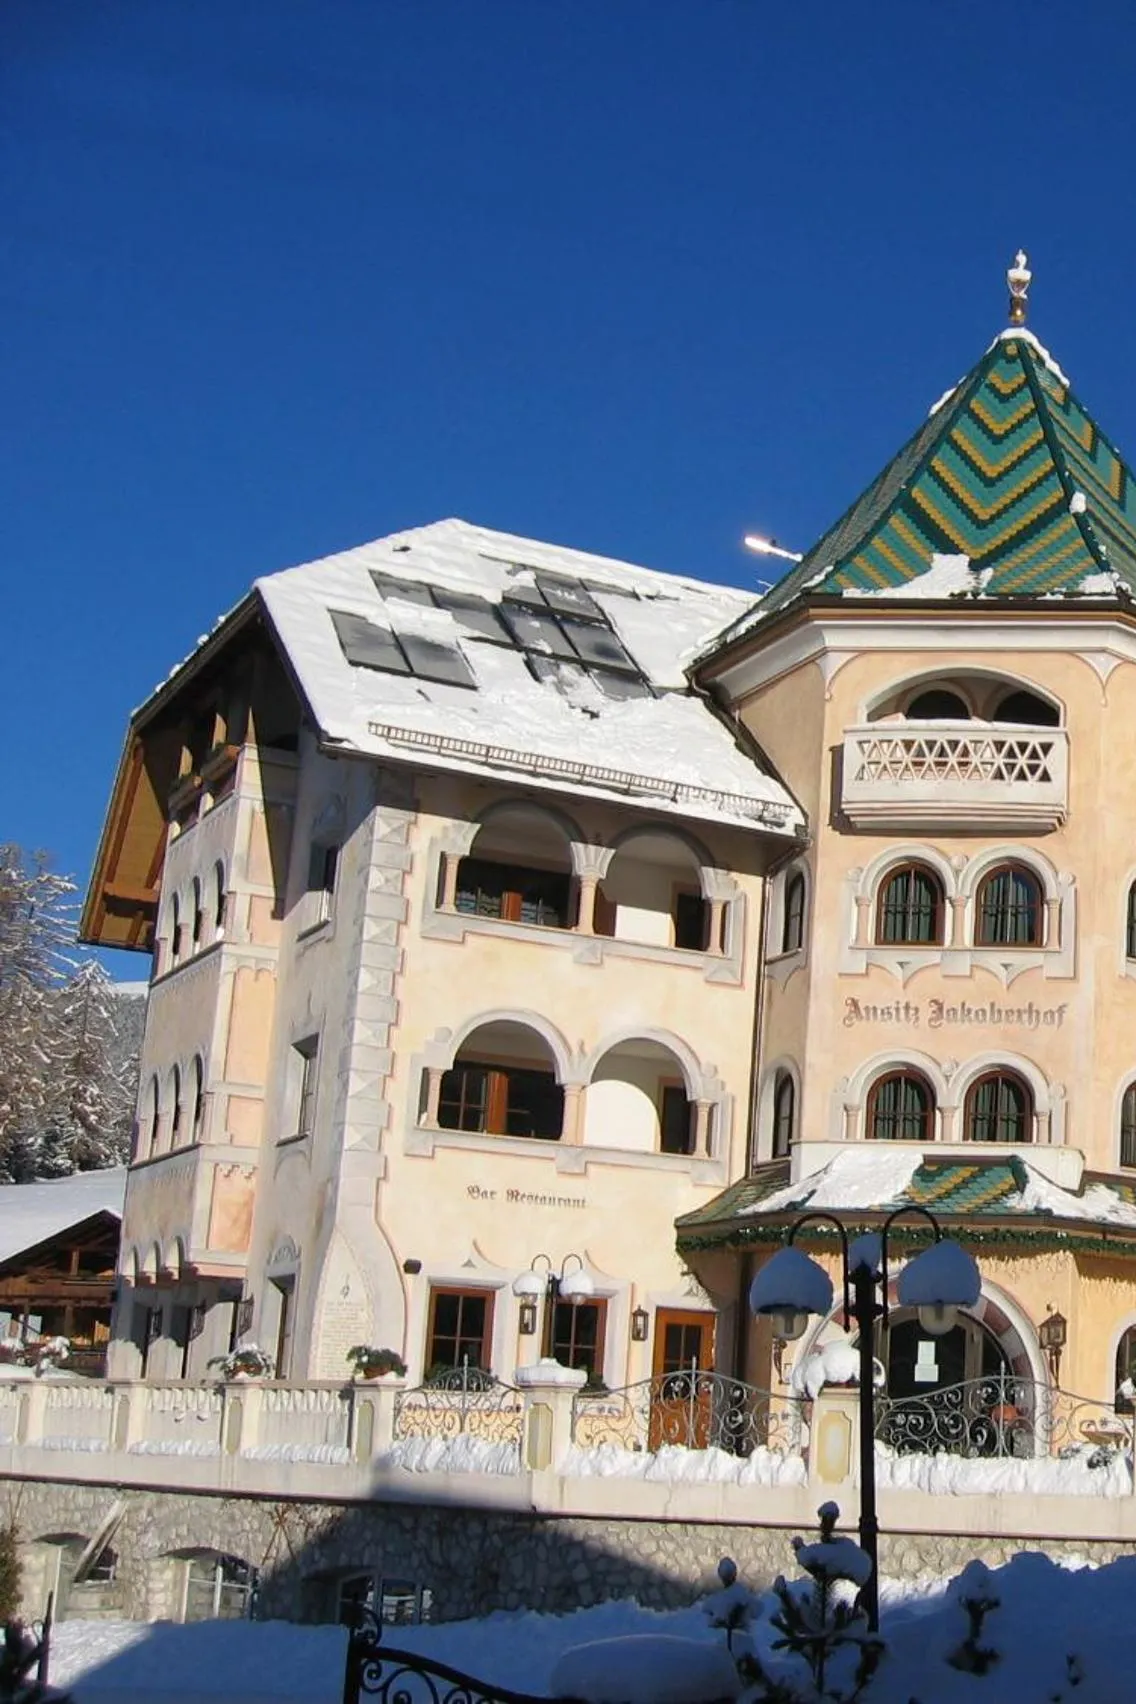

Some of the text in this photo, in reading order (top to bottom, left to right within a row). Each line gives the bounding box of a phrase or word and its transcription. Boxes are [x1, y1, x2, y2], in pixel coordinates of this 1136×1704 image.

[843, 997, 1068, 1031] Ansitz Jakoberhof
[467, 1185, 586, 1208] Bar Restaurant
